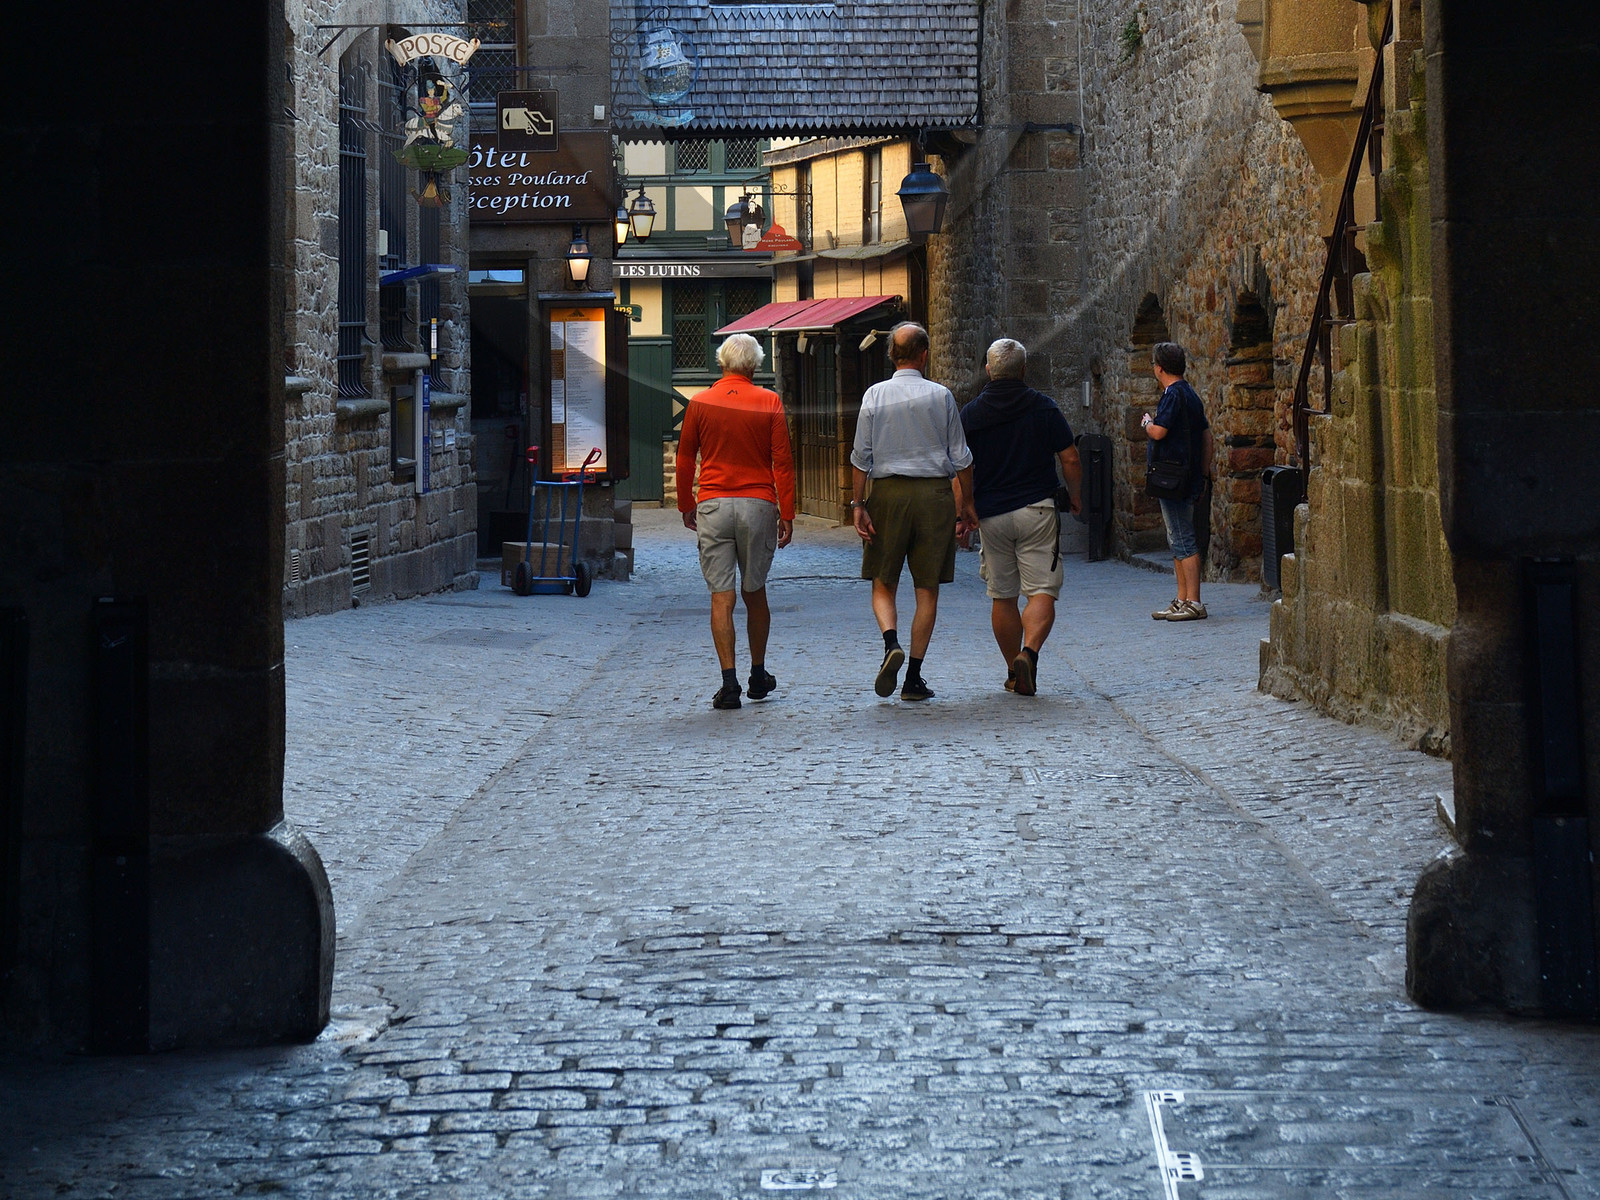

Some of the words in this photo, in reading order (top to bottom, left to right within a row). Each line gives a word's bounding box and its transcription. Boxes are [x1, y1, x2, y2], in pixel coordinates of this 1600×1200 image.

[399, 35, 469, 61] POSTE
[469, 144, 531, 168] ôtel
[468, 172, 501, 186] sses
[508, 170, 592, 186] Poulard
[468, 191, 572, 215] éception
[620, 265, 646, 276] LES
[649, 265, 701, 276] LUTINS
